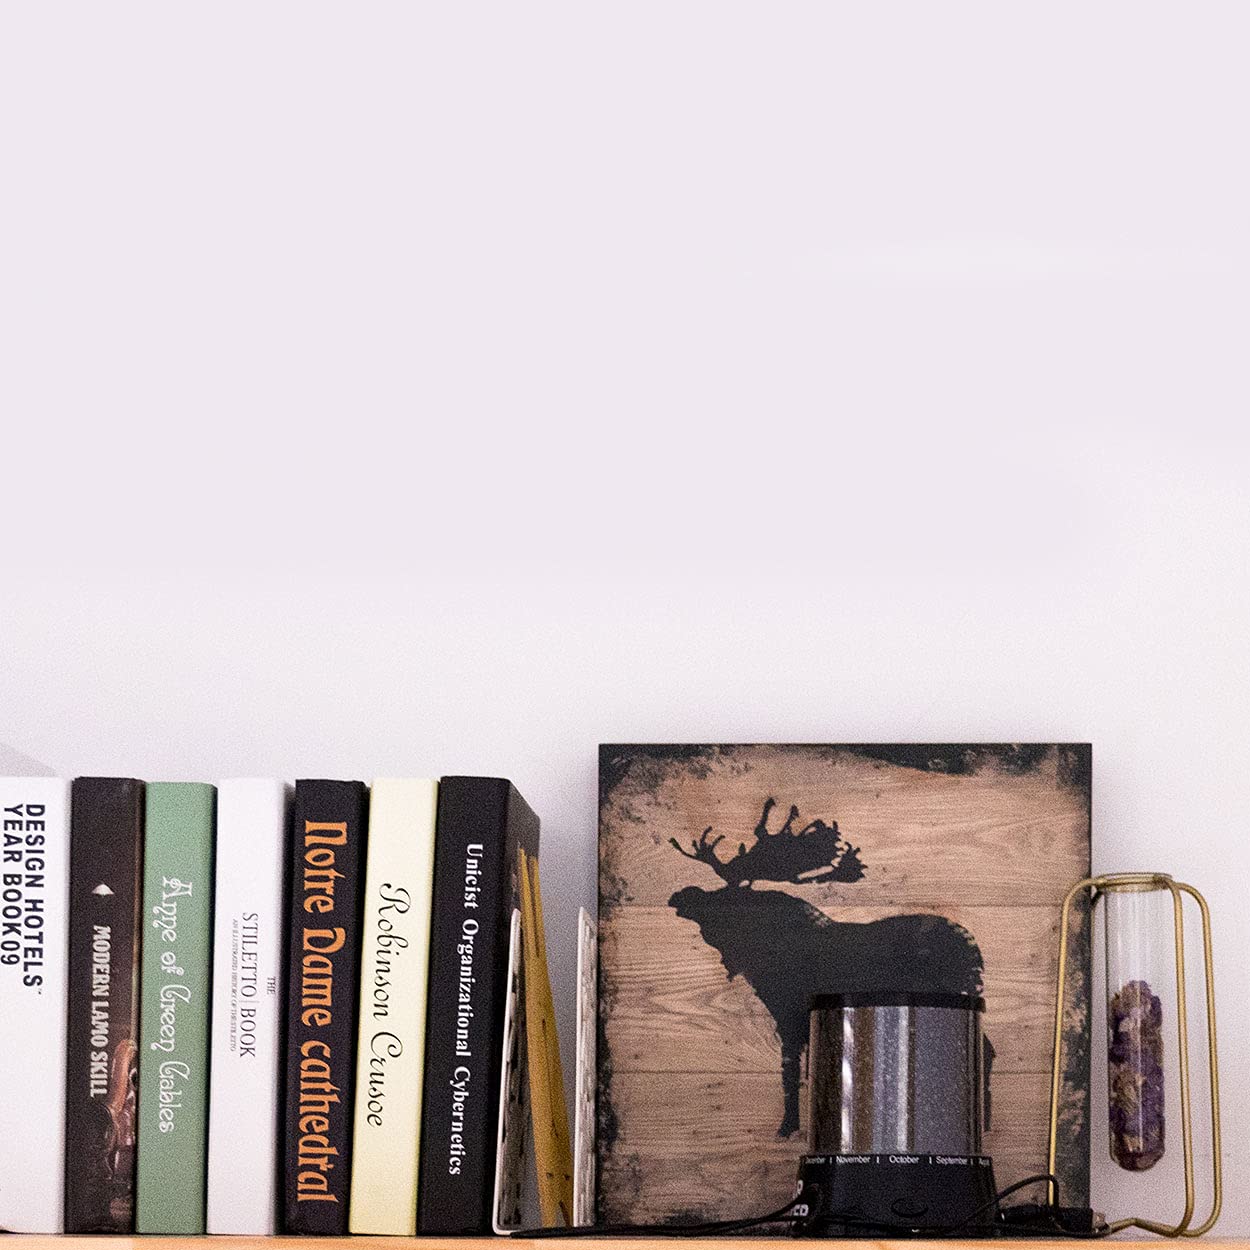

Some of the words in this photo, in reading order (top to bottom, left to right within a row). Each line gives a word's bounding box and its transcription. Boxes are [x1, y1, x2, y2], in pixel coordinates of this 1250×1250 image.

[3, 803, 24, 864] YEAR
[24, 803, 46, 888] DESIGN
[303, 820, 348, 914] Notre
[152, 876, 193, 942] Anne
[463, 843, 484, 909] Unicist
[22, 898, 45, 988] HOTELS
[91, 924, 112, 997] MODERN
[160, 951, 185, 977] of
[240, 912, 260, 998] STILETTO
[301, 927, 346, 1027] Dame
[372, 882, 411, 1020] Robinson
[150, 983, 192, 1053] Green
[266, 975, 277, 996] THE
[455, 918, 480, 1057] Organizational
[240, 1007, 258, 1058] BOOK
[89, 1050, 109, 1098] SKILL
[158, 1060, 191, 1134] Gables
[366, 1031, 403, 1128] Crusoe
[297, 1040, 340, 1202] cathedral
[448, 1066, 472, 1175] Cybernetics
[835, 1153, 871, 1165] November
[888, 1154, 920, 1165] October
